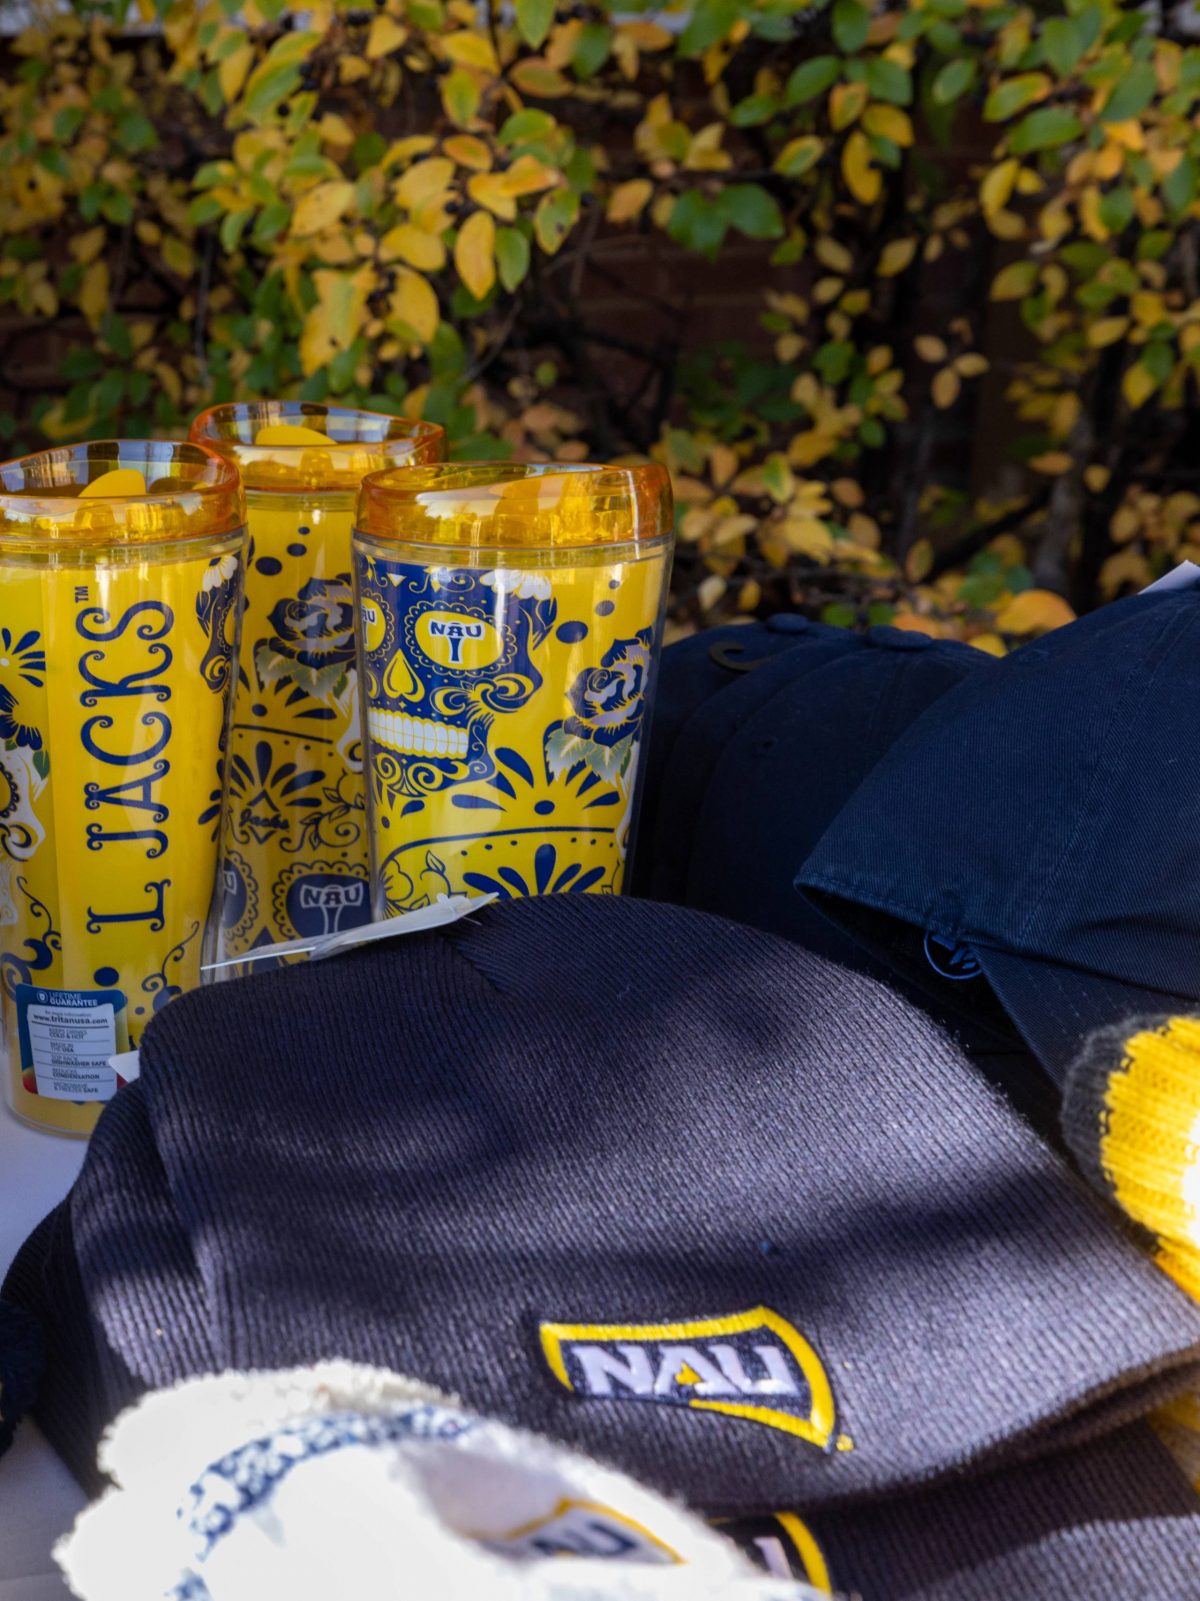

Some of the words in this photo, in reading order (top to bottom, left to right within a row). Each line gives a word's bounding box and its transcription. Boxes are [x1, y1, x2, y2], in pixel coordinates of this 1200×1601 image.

[430, 620, 482, 638] NAU
[75, 600, 175, 859] JACKS
[86, 878, 172, 934] L
[303, 885, 361, 906] NAU
[49, 998, 98, 1007] GUARANTEE
[33, 1014, 108, 1024] www.tritanusa.com
[571, 1344, 801, 1396] NAU
